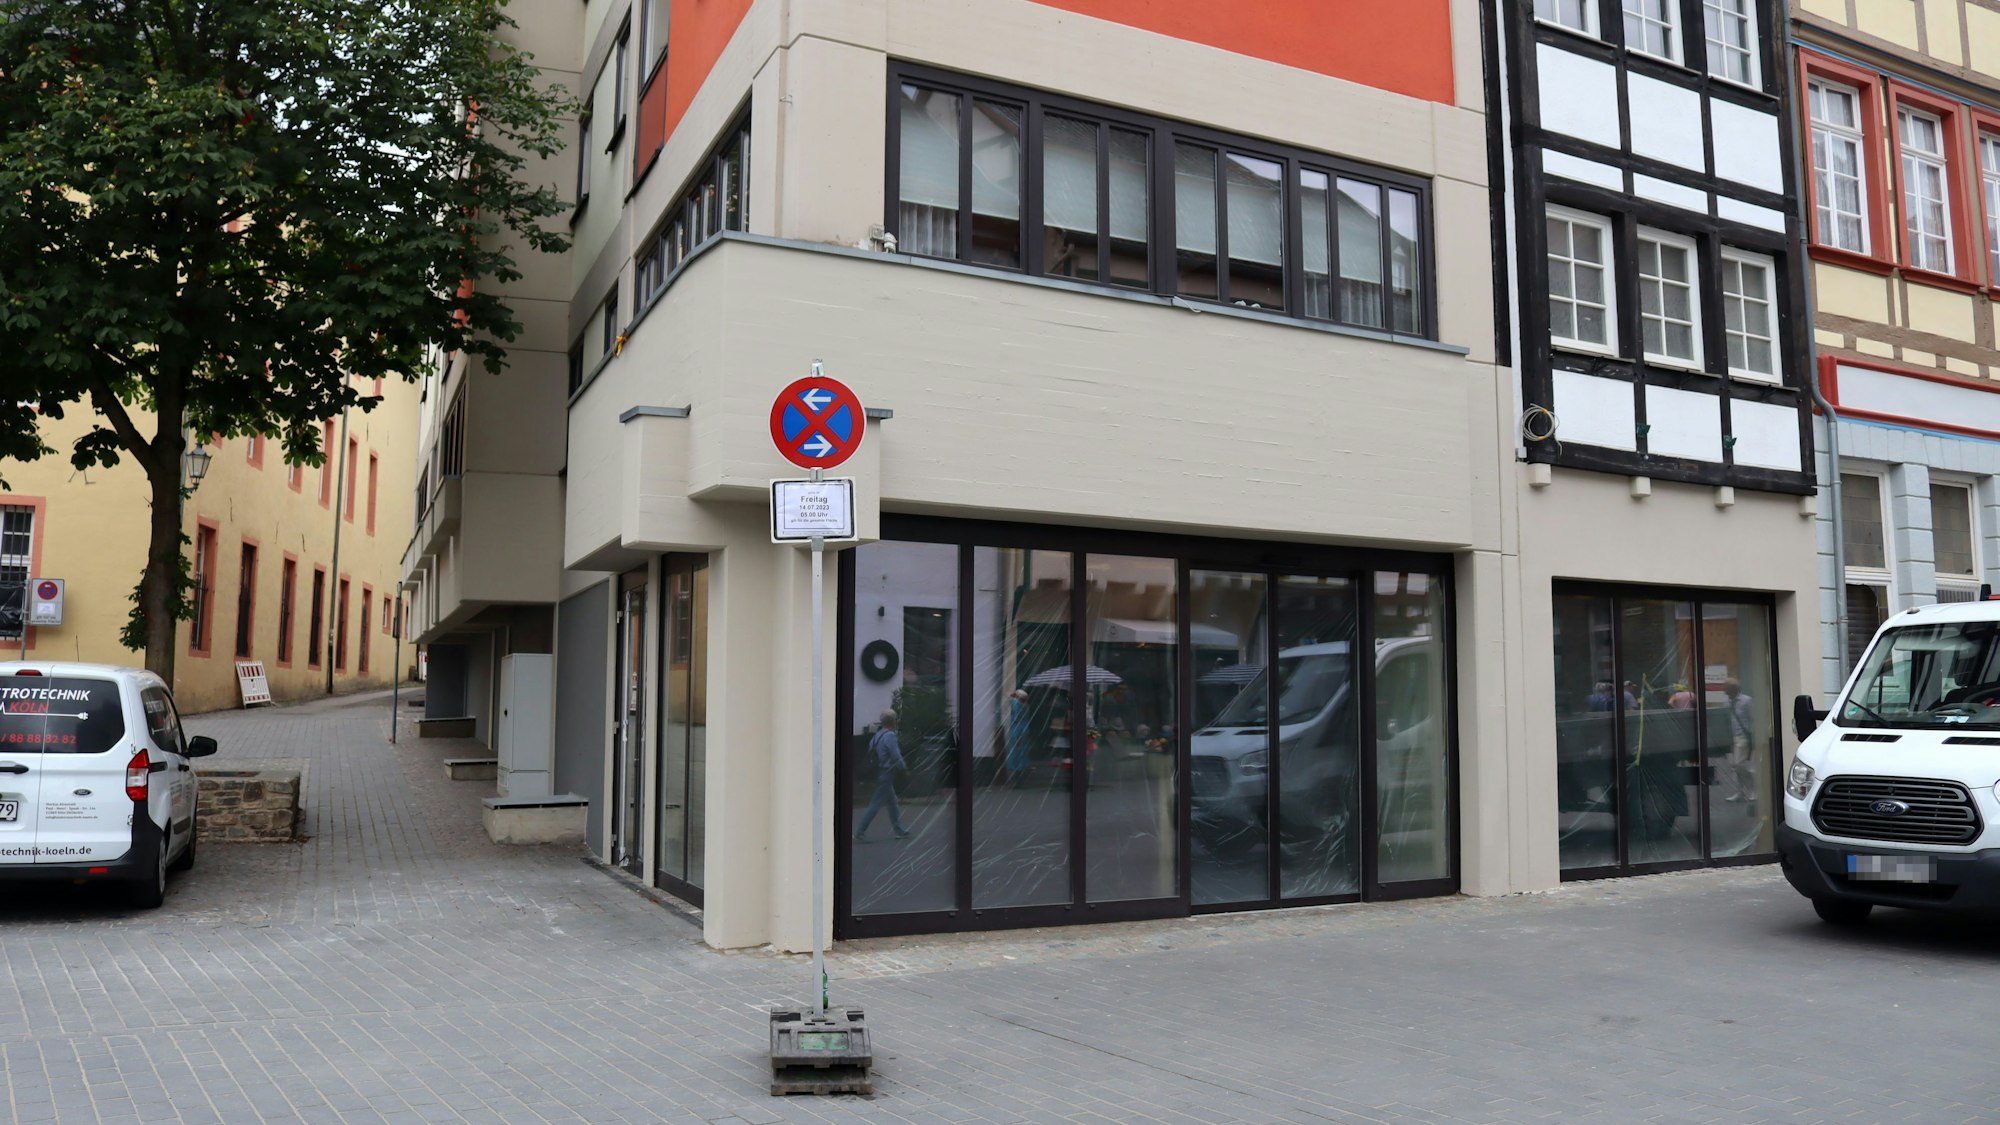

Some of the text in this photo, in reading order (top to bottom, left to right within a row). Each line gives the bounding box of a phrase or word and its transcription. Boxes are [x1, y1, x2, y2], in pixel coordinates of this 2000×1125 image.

[800, 496, 828, 504] Freitag
[0, 687, 91, 701] TROTECHNIK
[9, 699, 48, 712] KÖLN
[9, 733, 24, 743] 88
[27, 733, 42, 743] 88
[45, 734, 59, 743] 82
[62, 735, 77, 744] 82
[1876, 802, 1897, 812] Ford
[0, 845, 92, 856] technik-koeln.de
